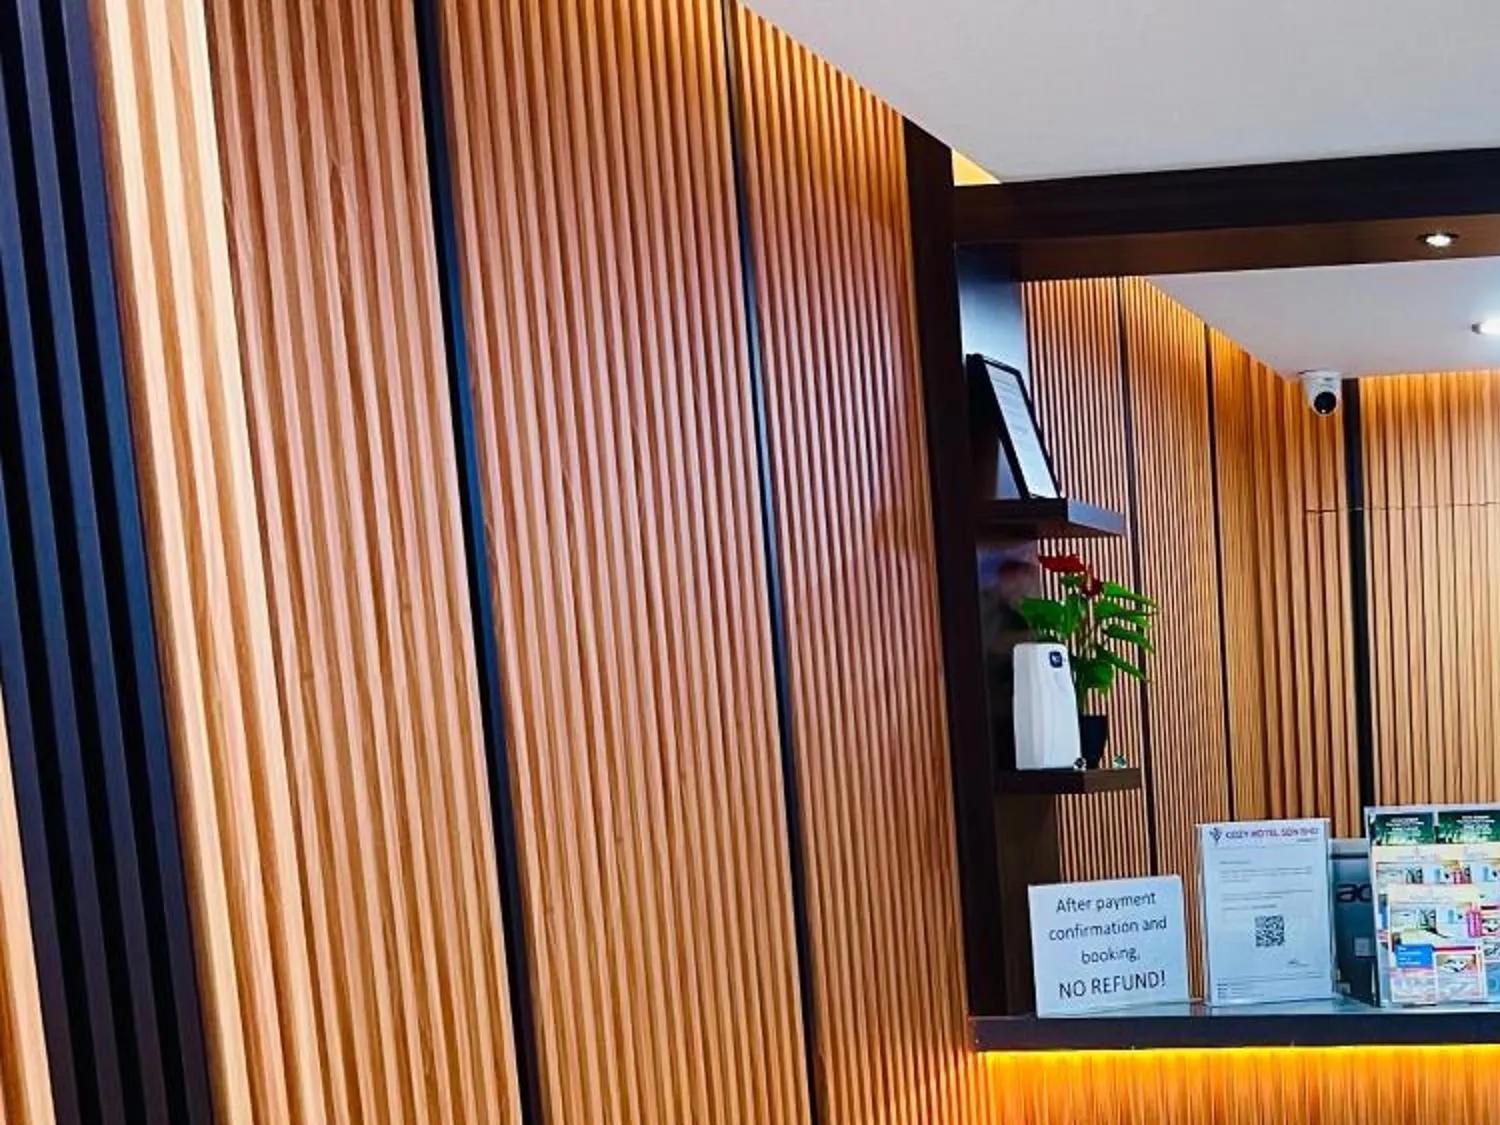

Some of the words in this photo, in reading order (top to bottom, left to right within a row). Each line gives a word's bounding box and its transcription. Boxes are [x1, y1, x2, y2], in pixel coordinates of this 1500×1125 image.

[1251, 829, 1278, 839] HOTEL
[1056, 897, 1091, 913] After
[1096, 892, 1156, 911] payment
[1049, 921, 1139, 941] confirmation
[1142, 915, 1167, 930] and
[1059, 979, 1086, 999] NO
[1092, 969, 1165, 995] REFUND!
